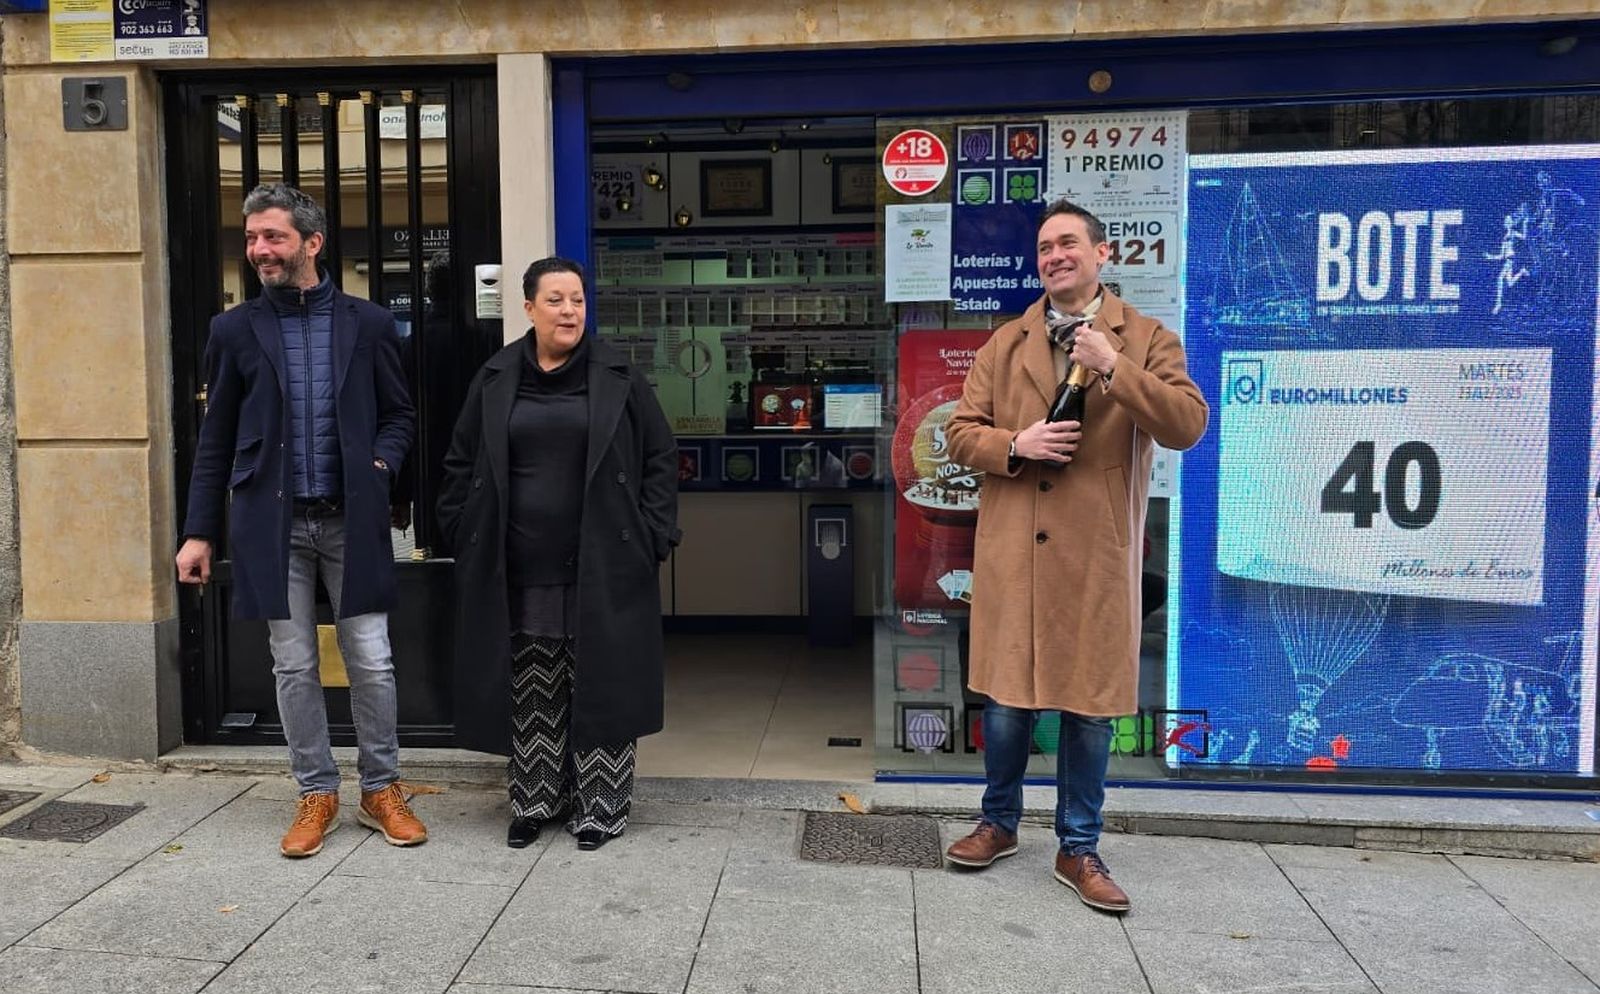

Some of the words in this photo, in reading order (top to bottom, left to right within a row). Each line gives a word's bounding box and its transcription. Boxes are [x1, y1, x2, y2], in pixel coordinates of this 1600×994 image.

[82, 81, 108, 125] 5
[1061, 126, 1168, 149] 94974
[896, 137, 933, 158] +18
[1082, 154, 1164, 172] PREMIO
[593, 182, 636, 198] 421
[953, 253, 1012, 268] Loterías
[1015, 255, 1024, 270] y
[1316, 209, 1464, 302] BOTE
[953, 275, 1018, 293] Apuestas
[954, 297, 1000, 311] Estado
[946, 358, 976, 368] Navid
[1458, 362, 1525, 381] MARTES
[1270, 387, 1408, 405] EUROMILLONES
[1320, 440, 1442, 530] 40
[1383, 558, 1454, 578] Millones
